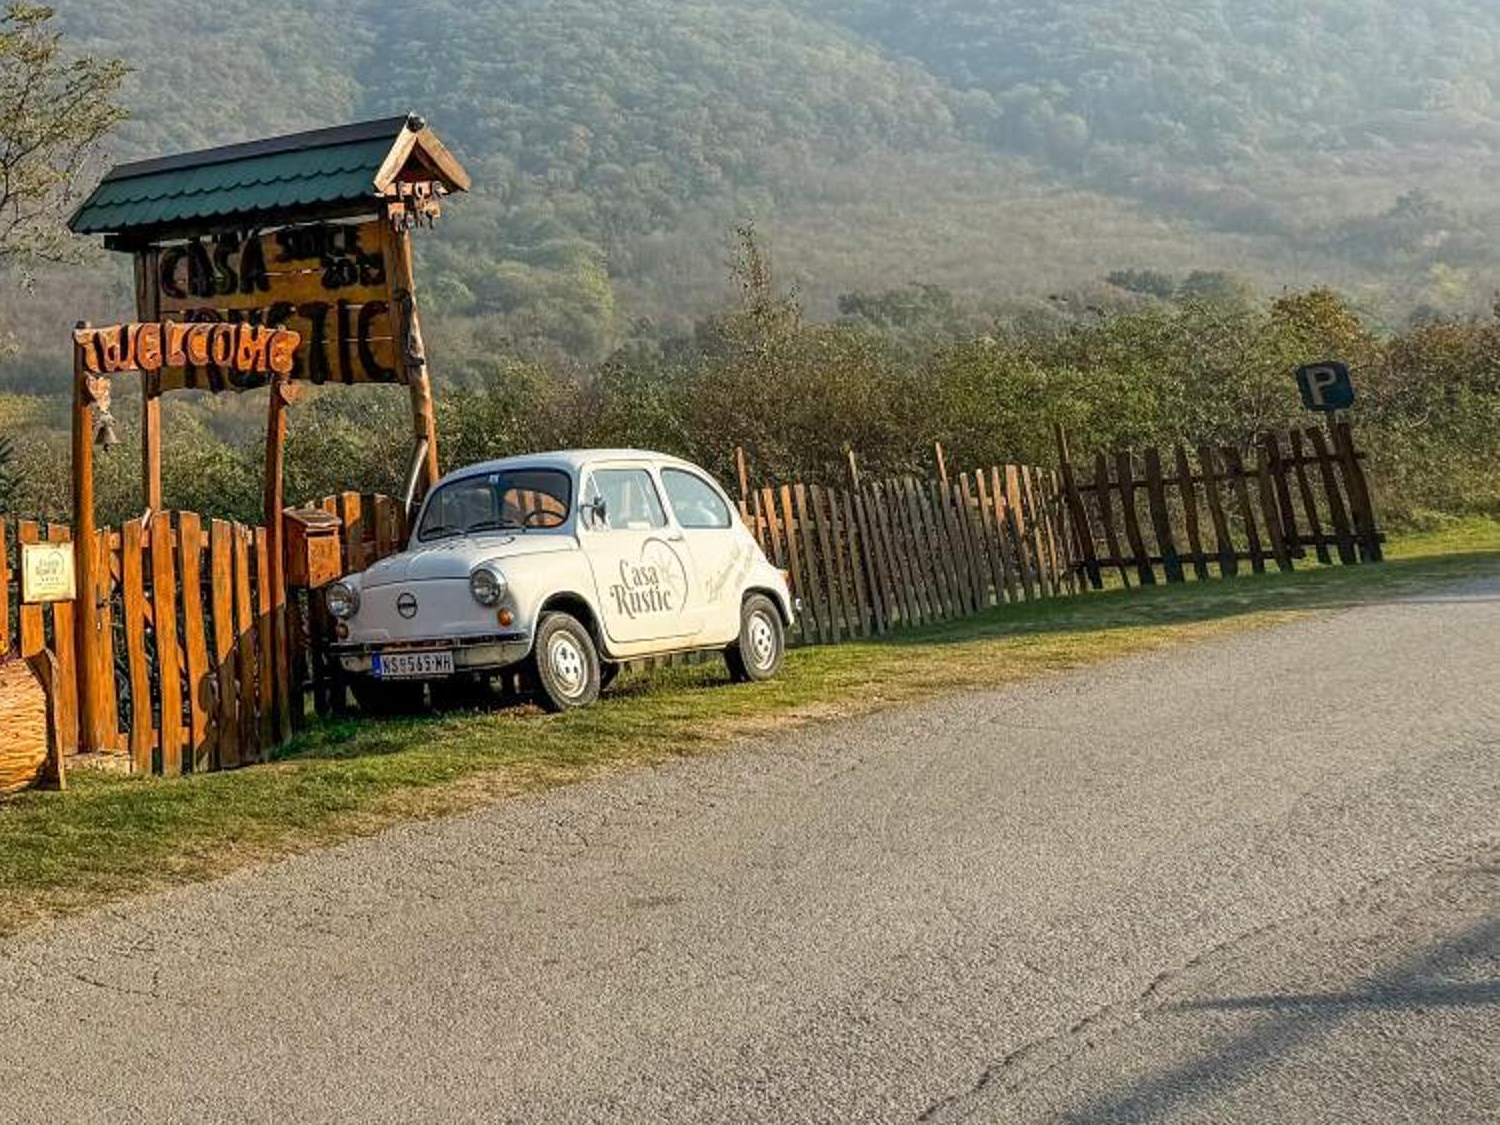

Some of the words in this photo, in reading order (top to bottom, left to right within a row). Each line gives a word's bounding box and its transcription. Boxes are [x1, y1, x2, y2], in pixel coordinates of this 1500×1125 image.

[160, 231, 270, 299] CASA
[98, 321, 296, 373] WELCOME
[1306, 366, 1337, 405] P
[619, 559, 659, 590] Casa
[610, 584, 673, 619] Rustic
